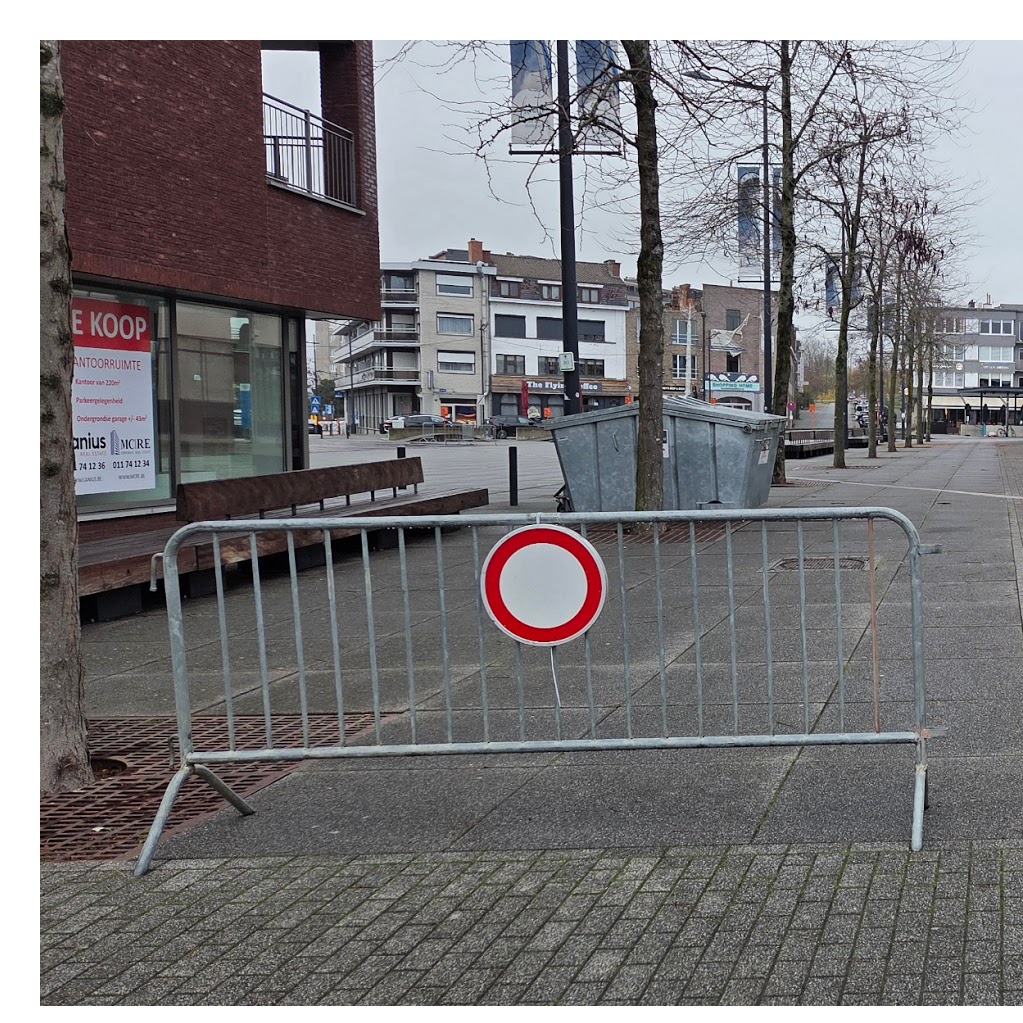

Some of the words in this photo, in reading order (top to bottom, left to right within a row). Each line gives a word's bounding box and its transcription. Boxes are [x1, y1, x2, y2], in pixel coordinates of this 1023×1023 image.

[90, 311, 147, 340] KOOP
[545, 382, 566, 390] Flyin
[79, 462, 87, 470] 74
[98, 462, 105, 470] 36
